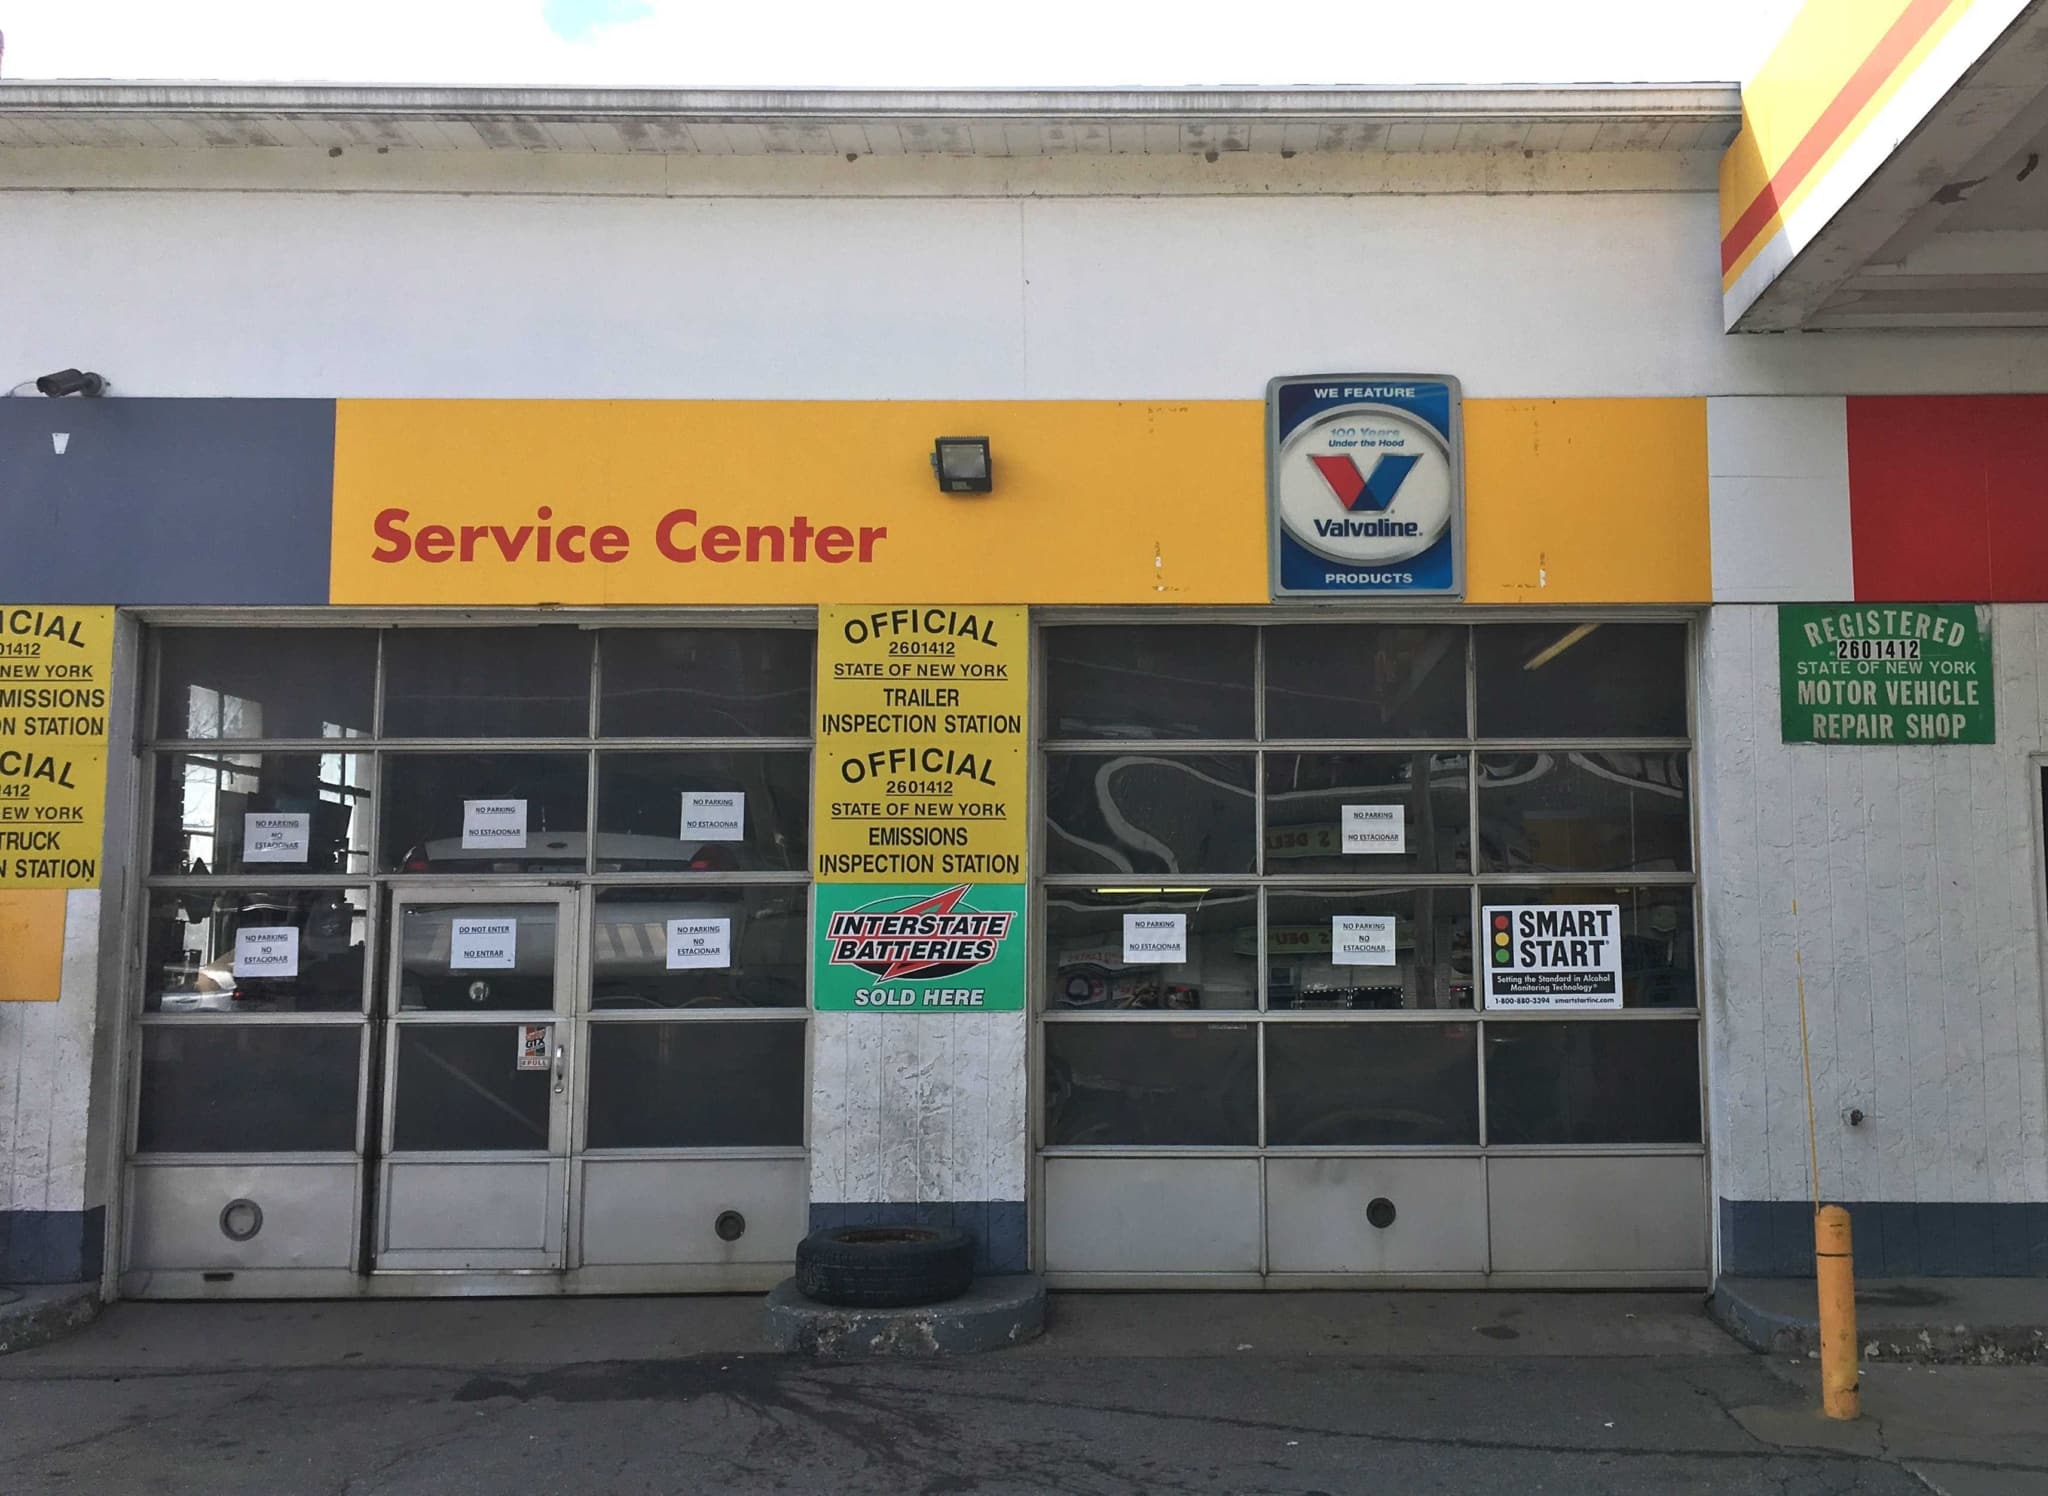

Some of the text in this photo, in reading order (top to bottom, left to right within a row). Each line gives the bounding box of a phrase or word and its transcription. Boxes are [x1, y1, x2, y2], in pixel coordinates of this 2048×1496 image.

[1314, 387, 1416, 398] WE FEATURE
[1330, 428, 1400, 437] 100 Years
[1328, 439, 1404, 448] Under the Hood
[371, 505, 888, 564] Service Center
[1314, 519, 1419, 537] Valvoline
[1325, 573, 1413, 584] PRODUCTS
[844, 608, 998, 647] OFFICIAL
[1804, 609, 1965, 648] REGISTERED
[888, 641, 956, 655] 2601412
[1838, 640, 1919, 659] 2601412
[0, 665, 93, 678] NEW YORK
[834, 663, 1008, 678] STATE OF NEW YORK
[1797, 661, 1976, 675] STATE OF NEW YORK
[884, 688, 960, 707] TRAILER
[1798, 680, 1980, 706] MOTOR VEHICLE
[24, 717, 104, 736] STATION
[822, 714, 1022, 734] INSPECTION STATION
[1812, 713, 1967, 739] REPAIR SHOP
[841, 748, 996, 786] OFFICIAL
[886, 781, 954, 794] 2601412
[34, 807, 84, 820] YORK
[831, 803, 1006, 816] STATE OF NEW YORK
[256, 820, 299, 828] NO PARKING
[0, 832, 60, 850] TRUCK
[271, 832, 283, 840] NO
[869, 827, 968, 847] EMISSIONS
[255, 842, 299, 850] ESTACIONAR
[15, 859, 95, 878] STATION
[819, 854, 1020, 874] INSPECTION STATION
[459, 926, 510, 934] DO NOT ENTER
[690, 926, 720, 934] PARKING
[833, 916, 1006, 936] INTERSTATE
[1519, 910, 1612, 938] SMART
[245, 934, 288, 943] NO PARKING
[693, 938, 705, 946] NO
[464, 950, 504, 959] NO ENTRAR
[677, 948, 720, 956] ESTACIONAR
[837, 940, 993, 960] BATTERIES
[1520, 940, 1605, 968] START
[244, 956, 288, 964] ESTACIONAR
[1497, 974, 1611, 984] Setting the Standard in Alcohol
[1510, 984, 1593, 993] Monitoring Technology
[855, 989, 984, 1006] SOLD HERE
